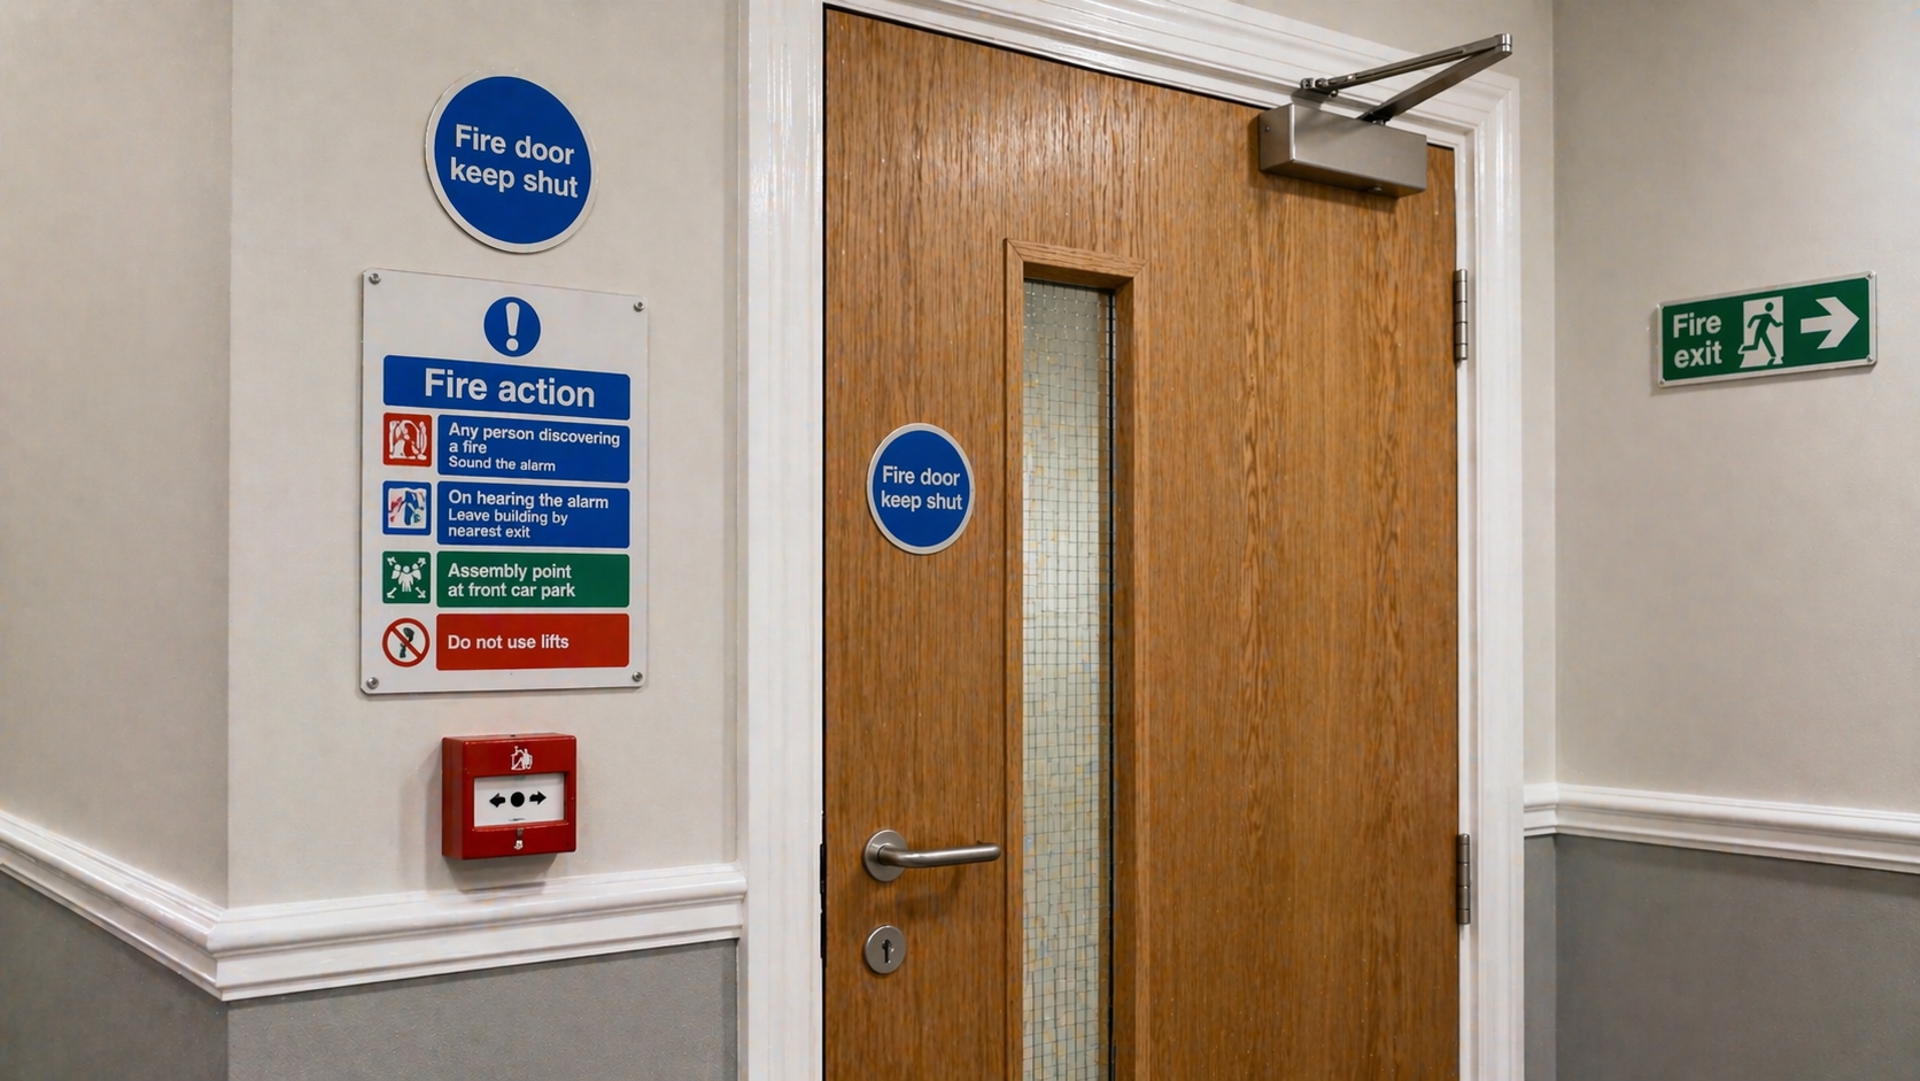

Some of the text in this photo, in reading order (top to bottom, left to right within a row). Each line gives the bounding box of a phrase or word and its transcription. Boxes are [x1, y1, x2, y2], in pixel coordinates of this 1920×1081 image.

[456, 124, 574, 164] Fire door
[451, 157, 578, 198] keep shut
[1674, 312, 1721, 338] Fire
[1674, 340, 1722, 368] exit
[426, 368, 594, 407] Fire action
[449, 422, 620, 448] Any person discovering
[449, 440, 487, 454] a fire
[449, 455, 555, 471] Sound the alarm
[883, 466, 960, 486] Fire door
[449, 489, 608, 509] On hearing the alarm
[882, 490, 962, 512] keep shut
[449, 508, 568, 526] Leave building by
[449, 525, 530, 538] nearest exit
[448, 563, 572, 582] Assembly point
[448, 582, 575, 600] at front car park
[448, 634, 569, 649] Do not use lifts
